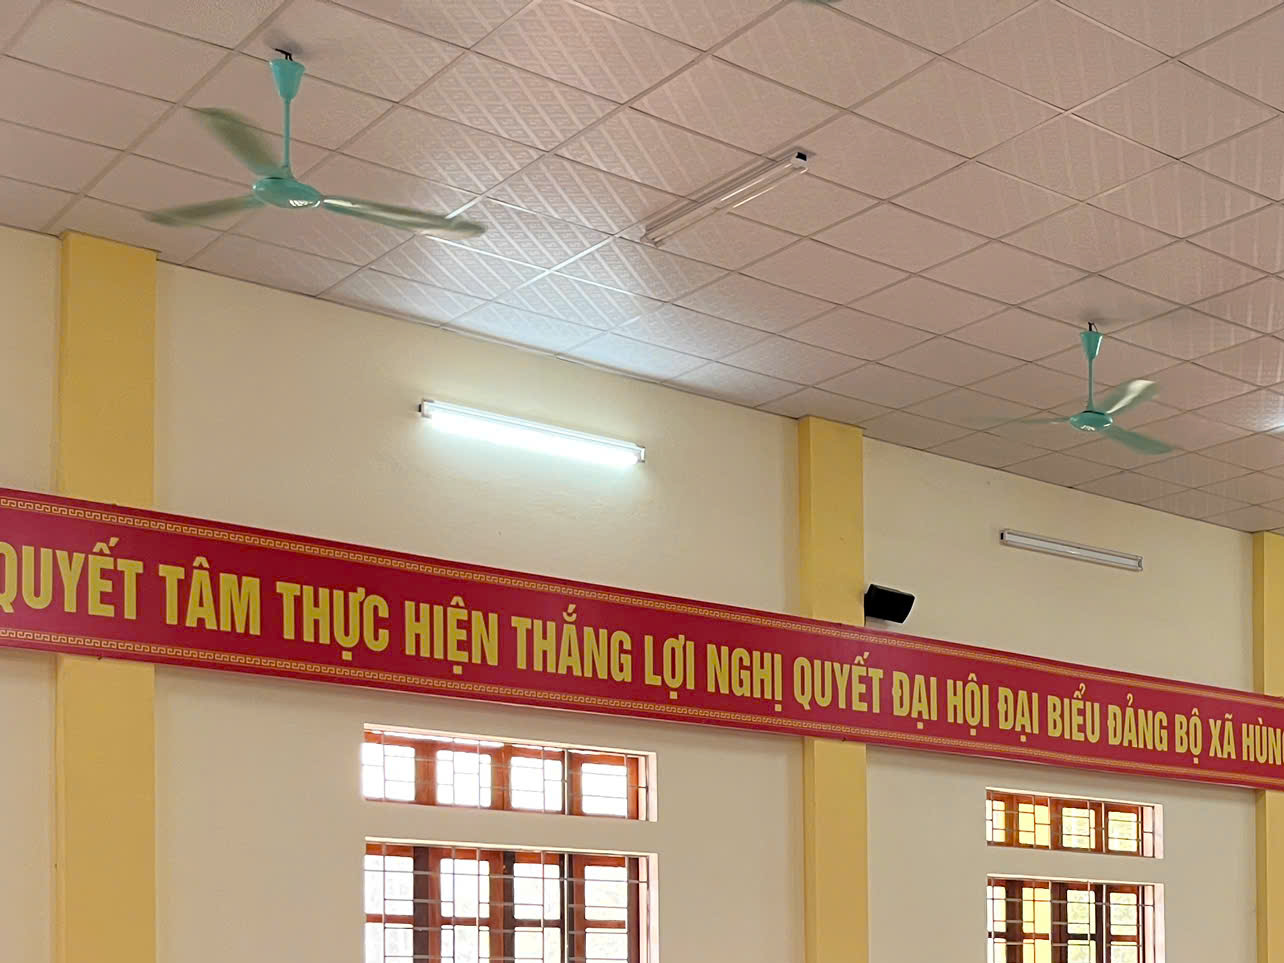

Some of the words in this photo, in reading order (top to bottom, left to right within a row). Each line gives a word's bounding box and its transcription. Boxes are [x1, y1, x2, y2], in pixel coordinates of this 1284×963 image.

[0, 537, 143, 619] QUYẾT
[159, 557, 260, 635] TÂM
[276, 582, 389, 660] THỰC
[404, 596, 499, 674] HIỆN
[512, 604, 632, 682] THẮNG
[645, 635, 694, 699] LỢI
[706, 644, 782, 711] NGHỊ
[794, 652, 883, 713] QUYẾT
[892, 671, 937, 729] ĐẠI
[947, 673, 989, 735] HỘI
[998, 687, 1039, 742] ĐẠI
[1048, 683, 1100, 743] BIỂU
[1107, 694, 1167, 751] ĐẢNG
[1175, 708, 1202, 764] BỘ
[1209, 713, 1236, 759] XÃ
